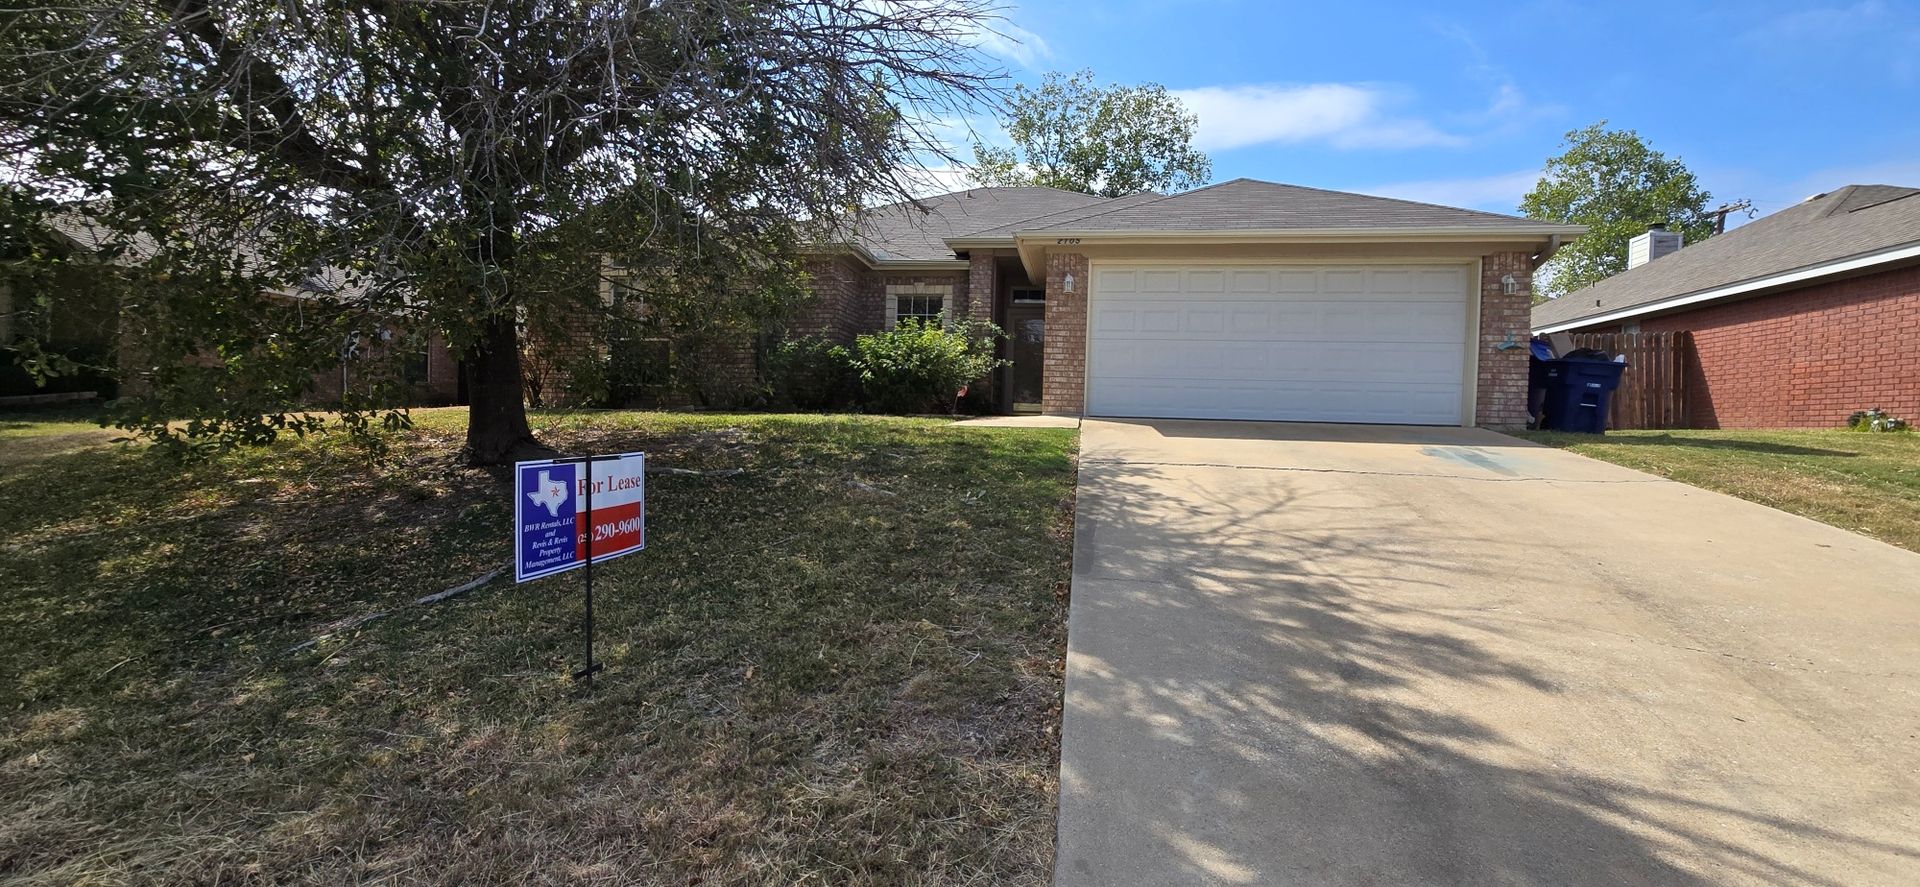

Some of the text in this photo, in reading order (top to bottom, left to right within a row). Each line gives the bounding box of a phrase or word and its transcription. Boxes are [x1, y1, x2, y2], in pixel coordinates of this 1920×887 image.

[578, 475, 641, 495] For Lease
[562, 516, 575, 526] LLC
[544, 528, 557, 538] and
[595, 517, 640, 541] 290-9600
[547, 538, 553, 546] &
[539, 546, 562, 557] Property
[562, 550, 575, 561] LLC
